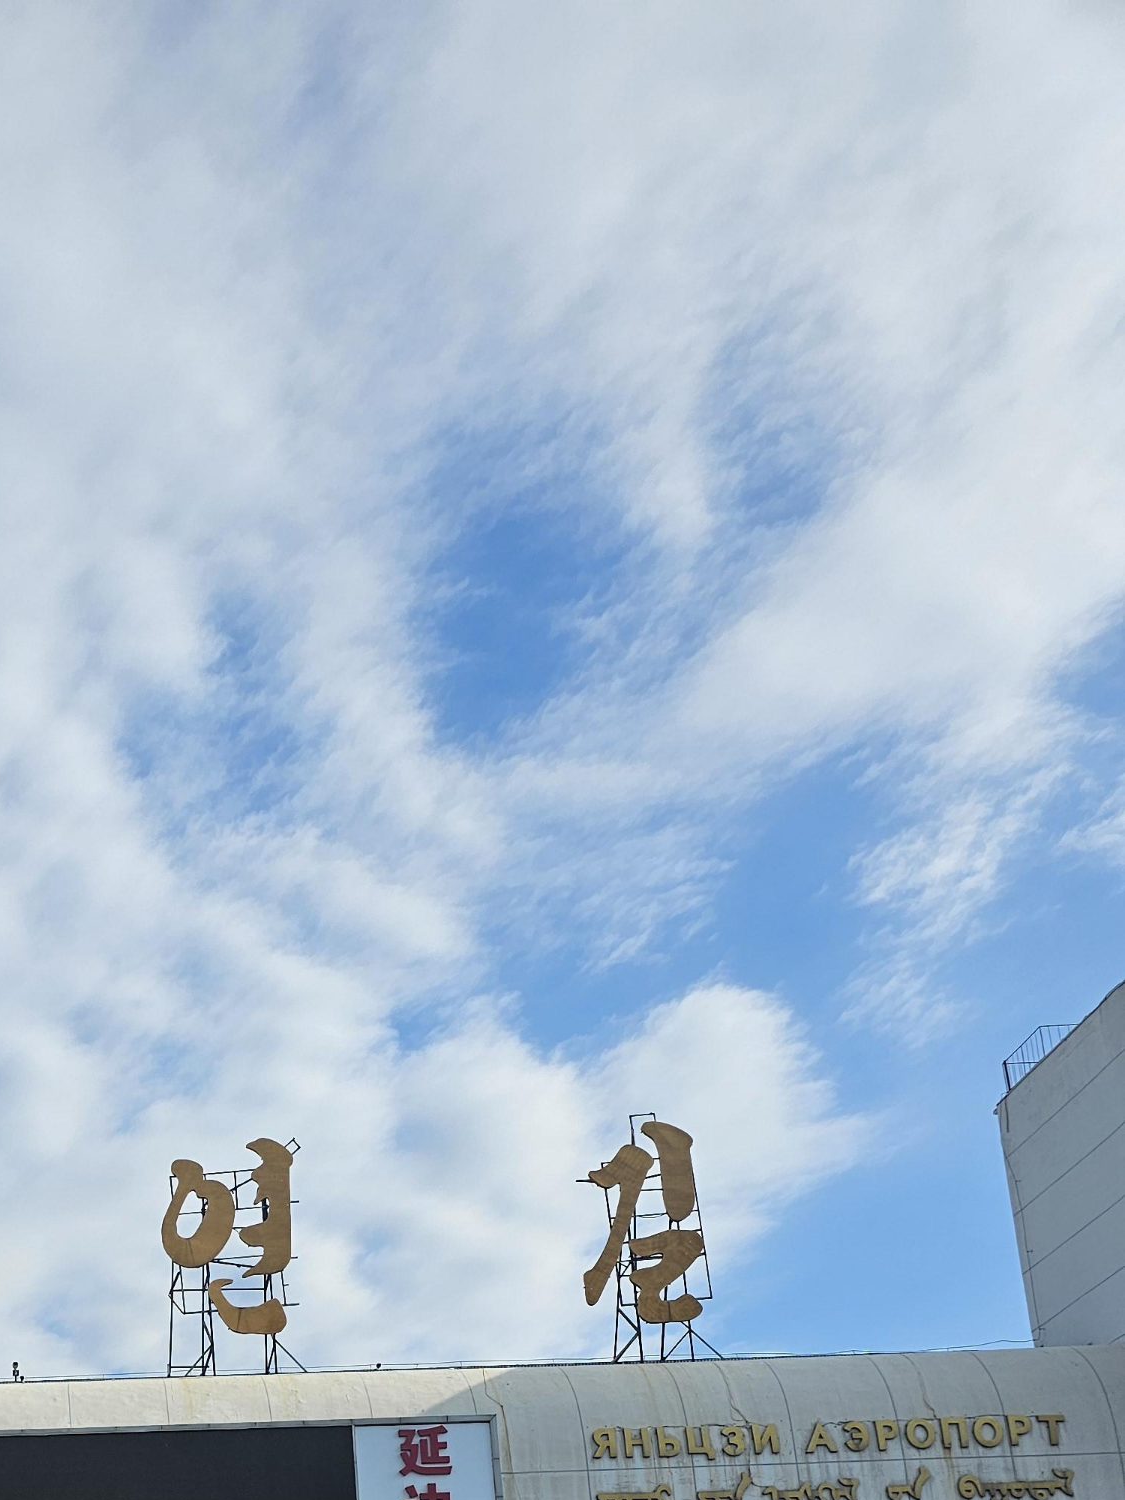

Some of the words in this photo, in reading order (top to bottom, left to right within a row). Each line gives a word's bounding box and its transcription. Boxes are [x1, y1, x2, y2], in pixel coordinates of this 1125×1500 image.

[161, 1120, 705, 1335] 연길
[591, 1422, 781, 1460] ЯНЬЦЗИ
[805, 1413, 1066, 1453] АЭРОПОРТ
